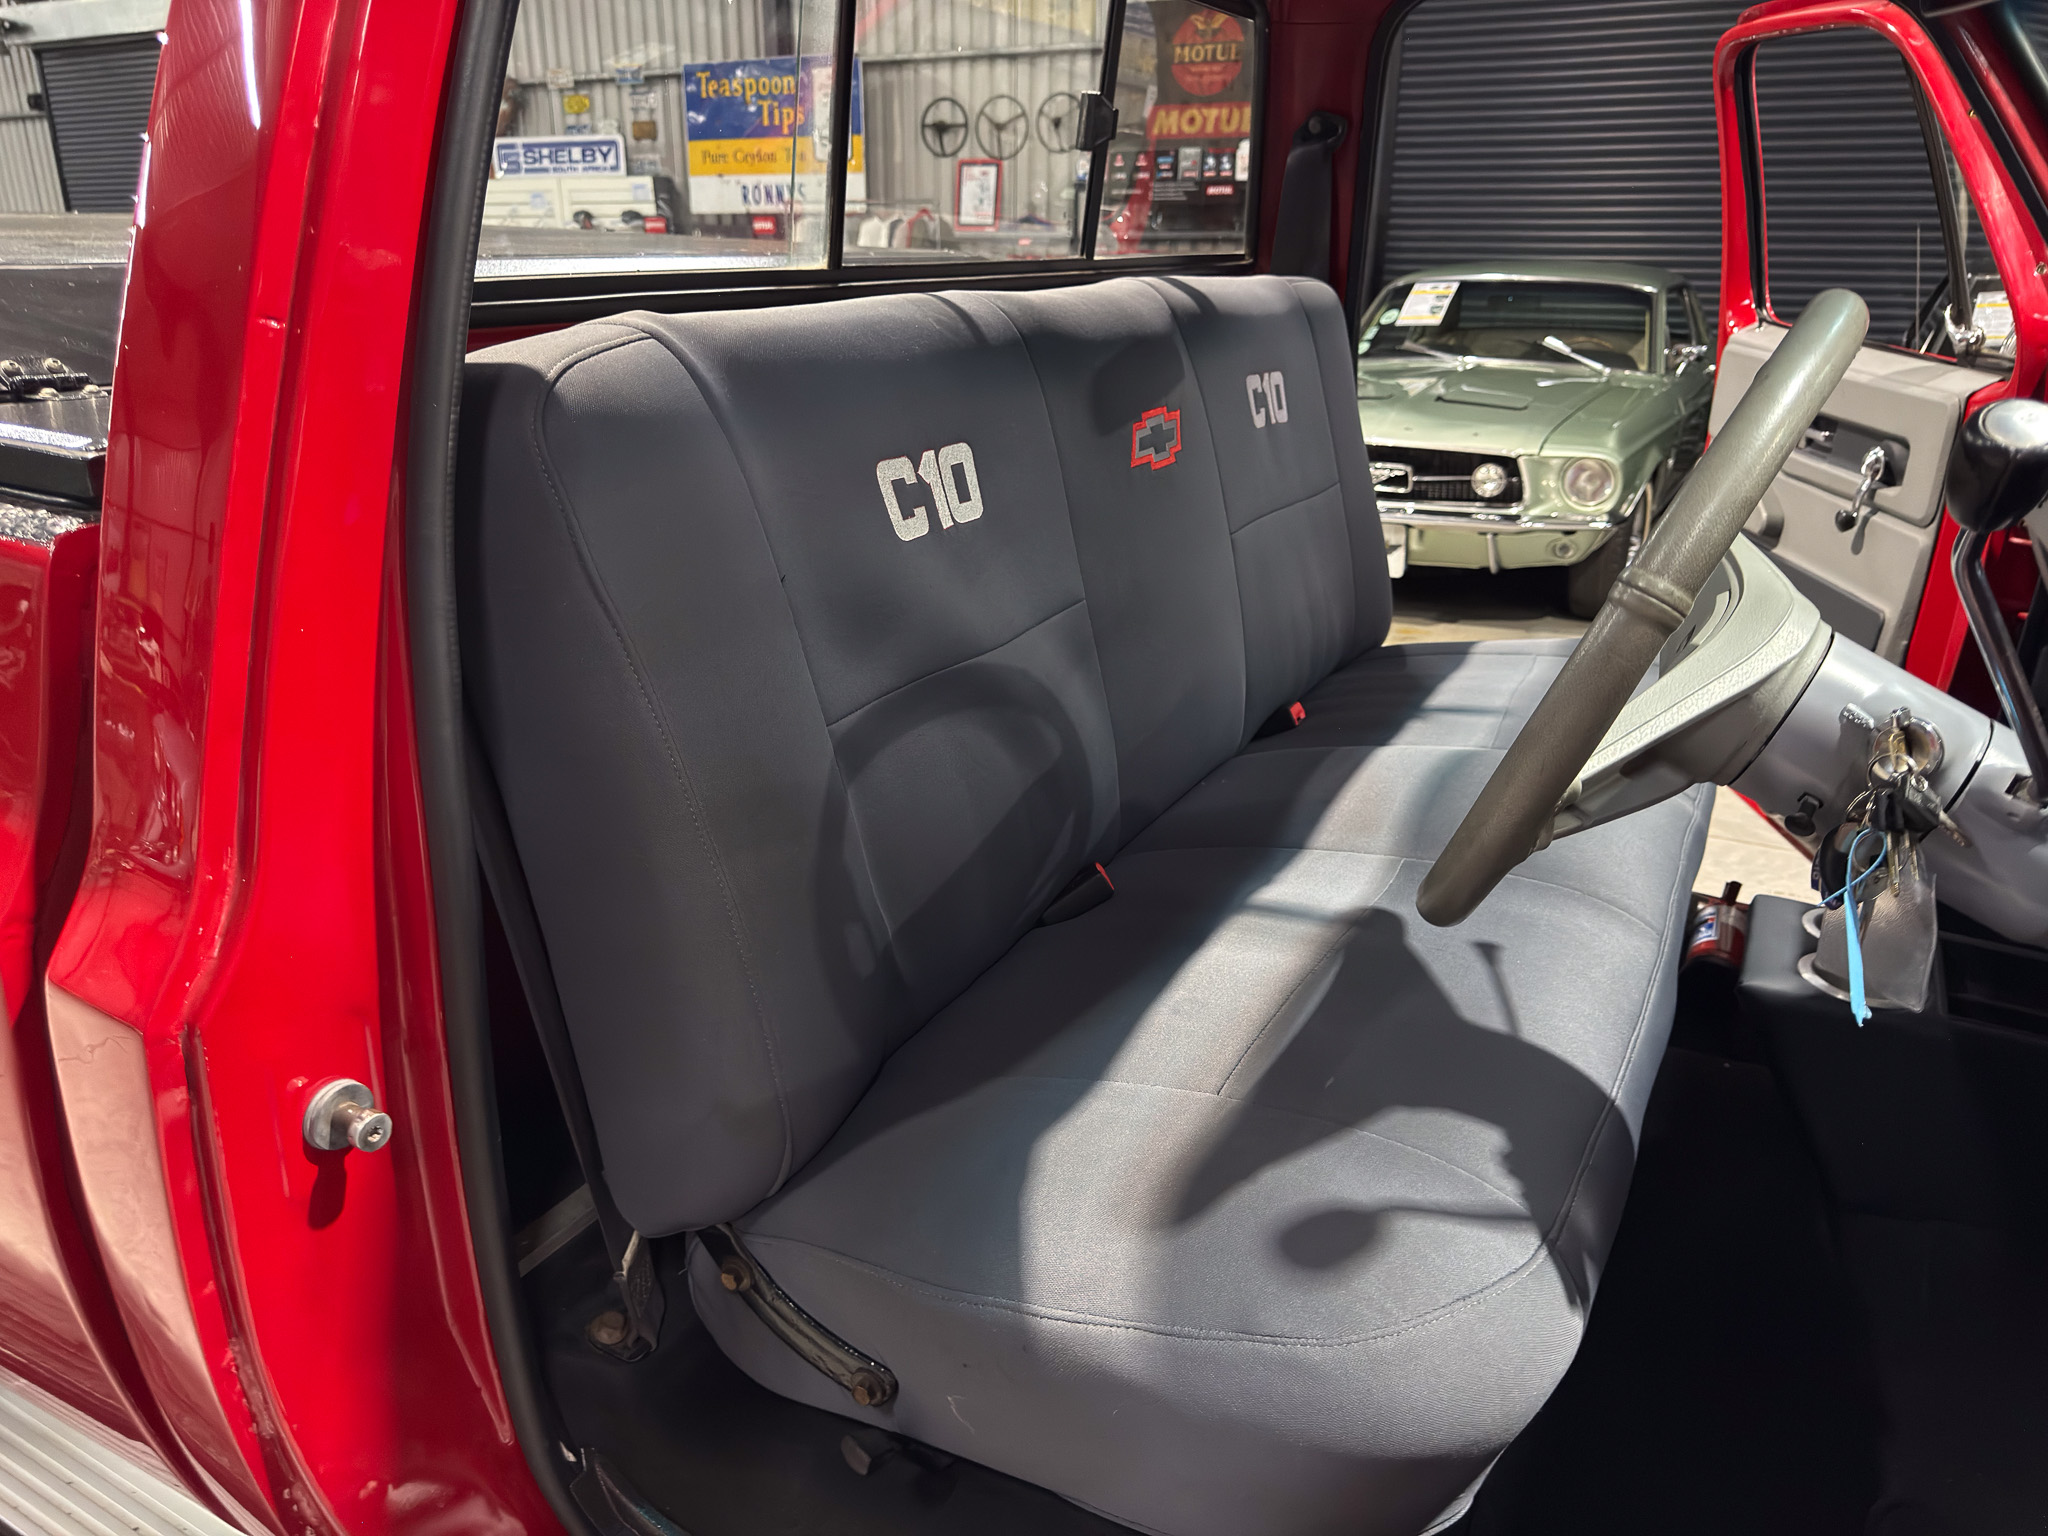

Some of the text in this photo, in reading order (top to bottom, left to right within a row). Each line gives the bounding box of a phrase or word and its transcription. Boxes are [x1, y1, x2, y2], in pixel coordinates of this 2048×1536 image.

[1174, 43, 1240, 63] MOTUL
[696, 71, 796, 105] Teaspoon
[757, 98, 805, 135] Tips
[523, 146, 611, 165] SHELBY
[701, 150, 729, 164] Pure
[784, 147, 807, 162] Ta
[1246, 370, 1288, 429] C10
[876, 442, 984, 542] C10
